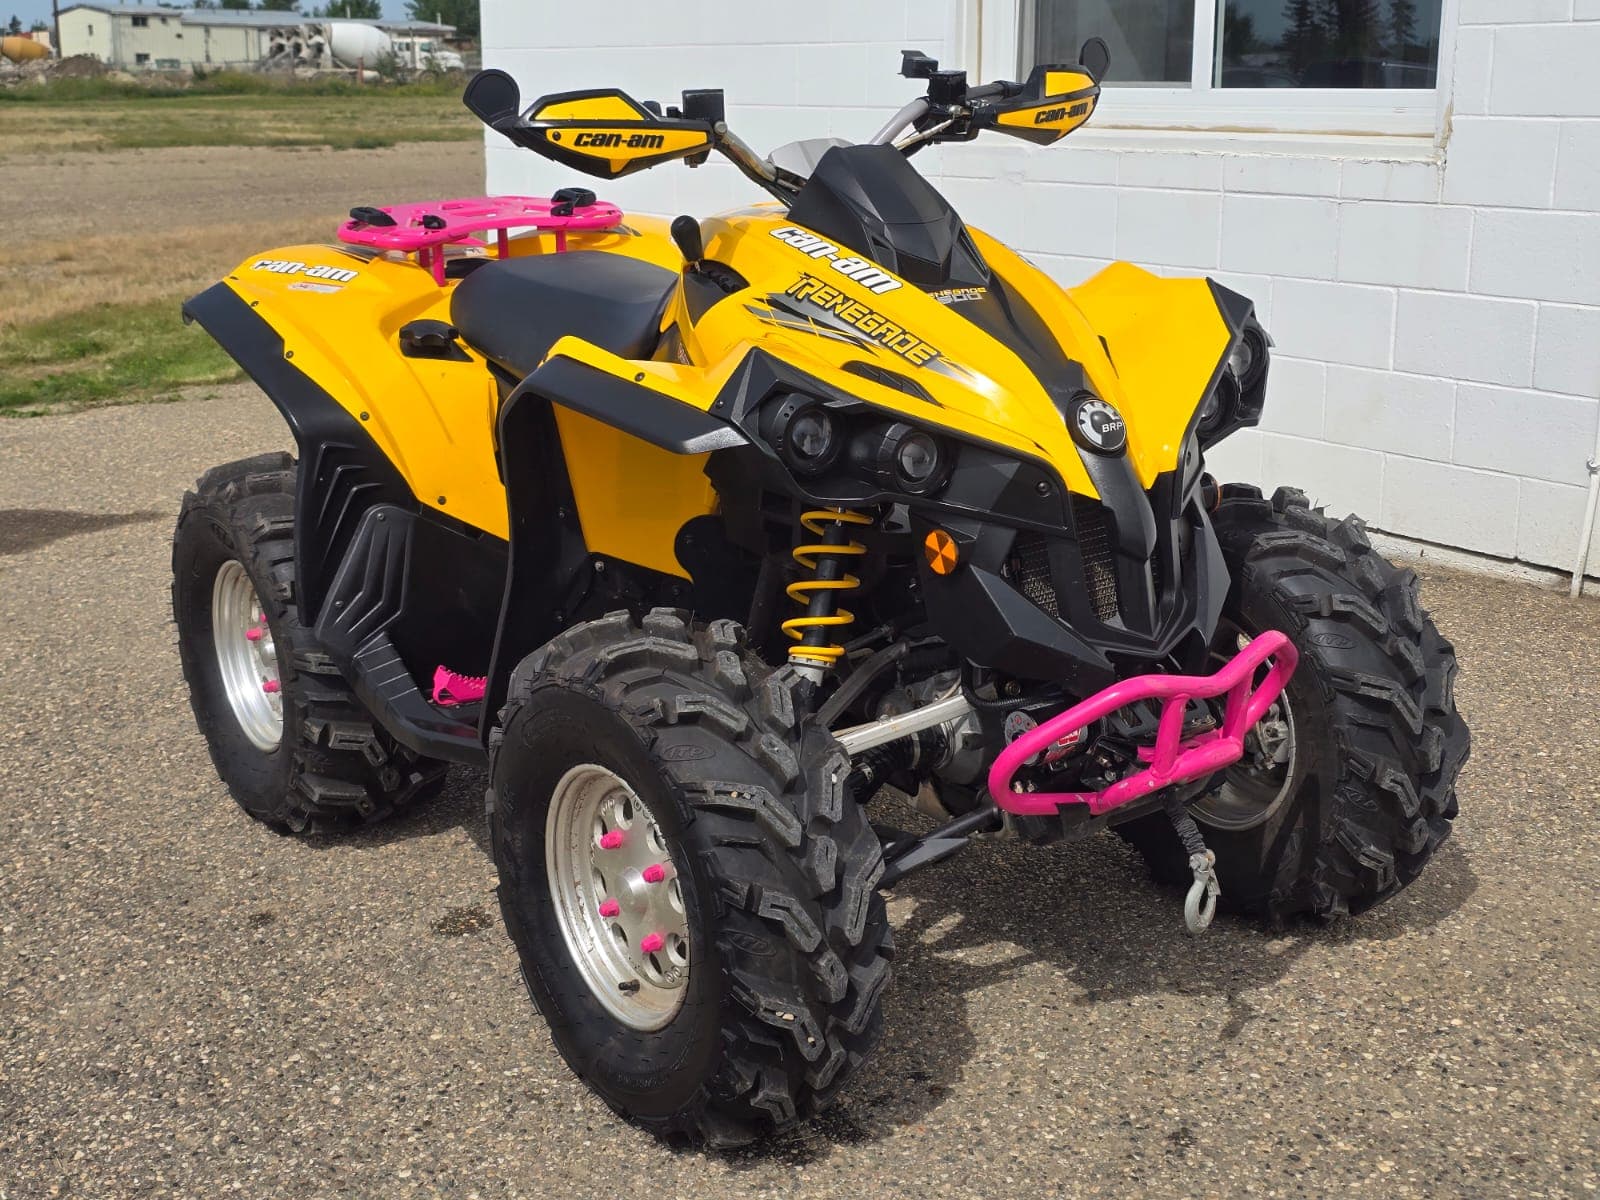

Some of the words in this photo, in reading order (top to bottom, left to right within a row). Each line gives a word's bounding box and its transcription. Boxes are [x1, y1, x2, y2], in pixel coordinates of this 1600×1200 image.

[1034, 103, 1088, 124] can-am
[574, 132, 664, 149] can-am
[251, 260, 359, 282] can-am
[769, 226, 903, 295] can-am
[786, 271, 939, 366] RENEGADE
[1102, 421, 1123, 432] BRP
